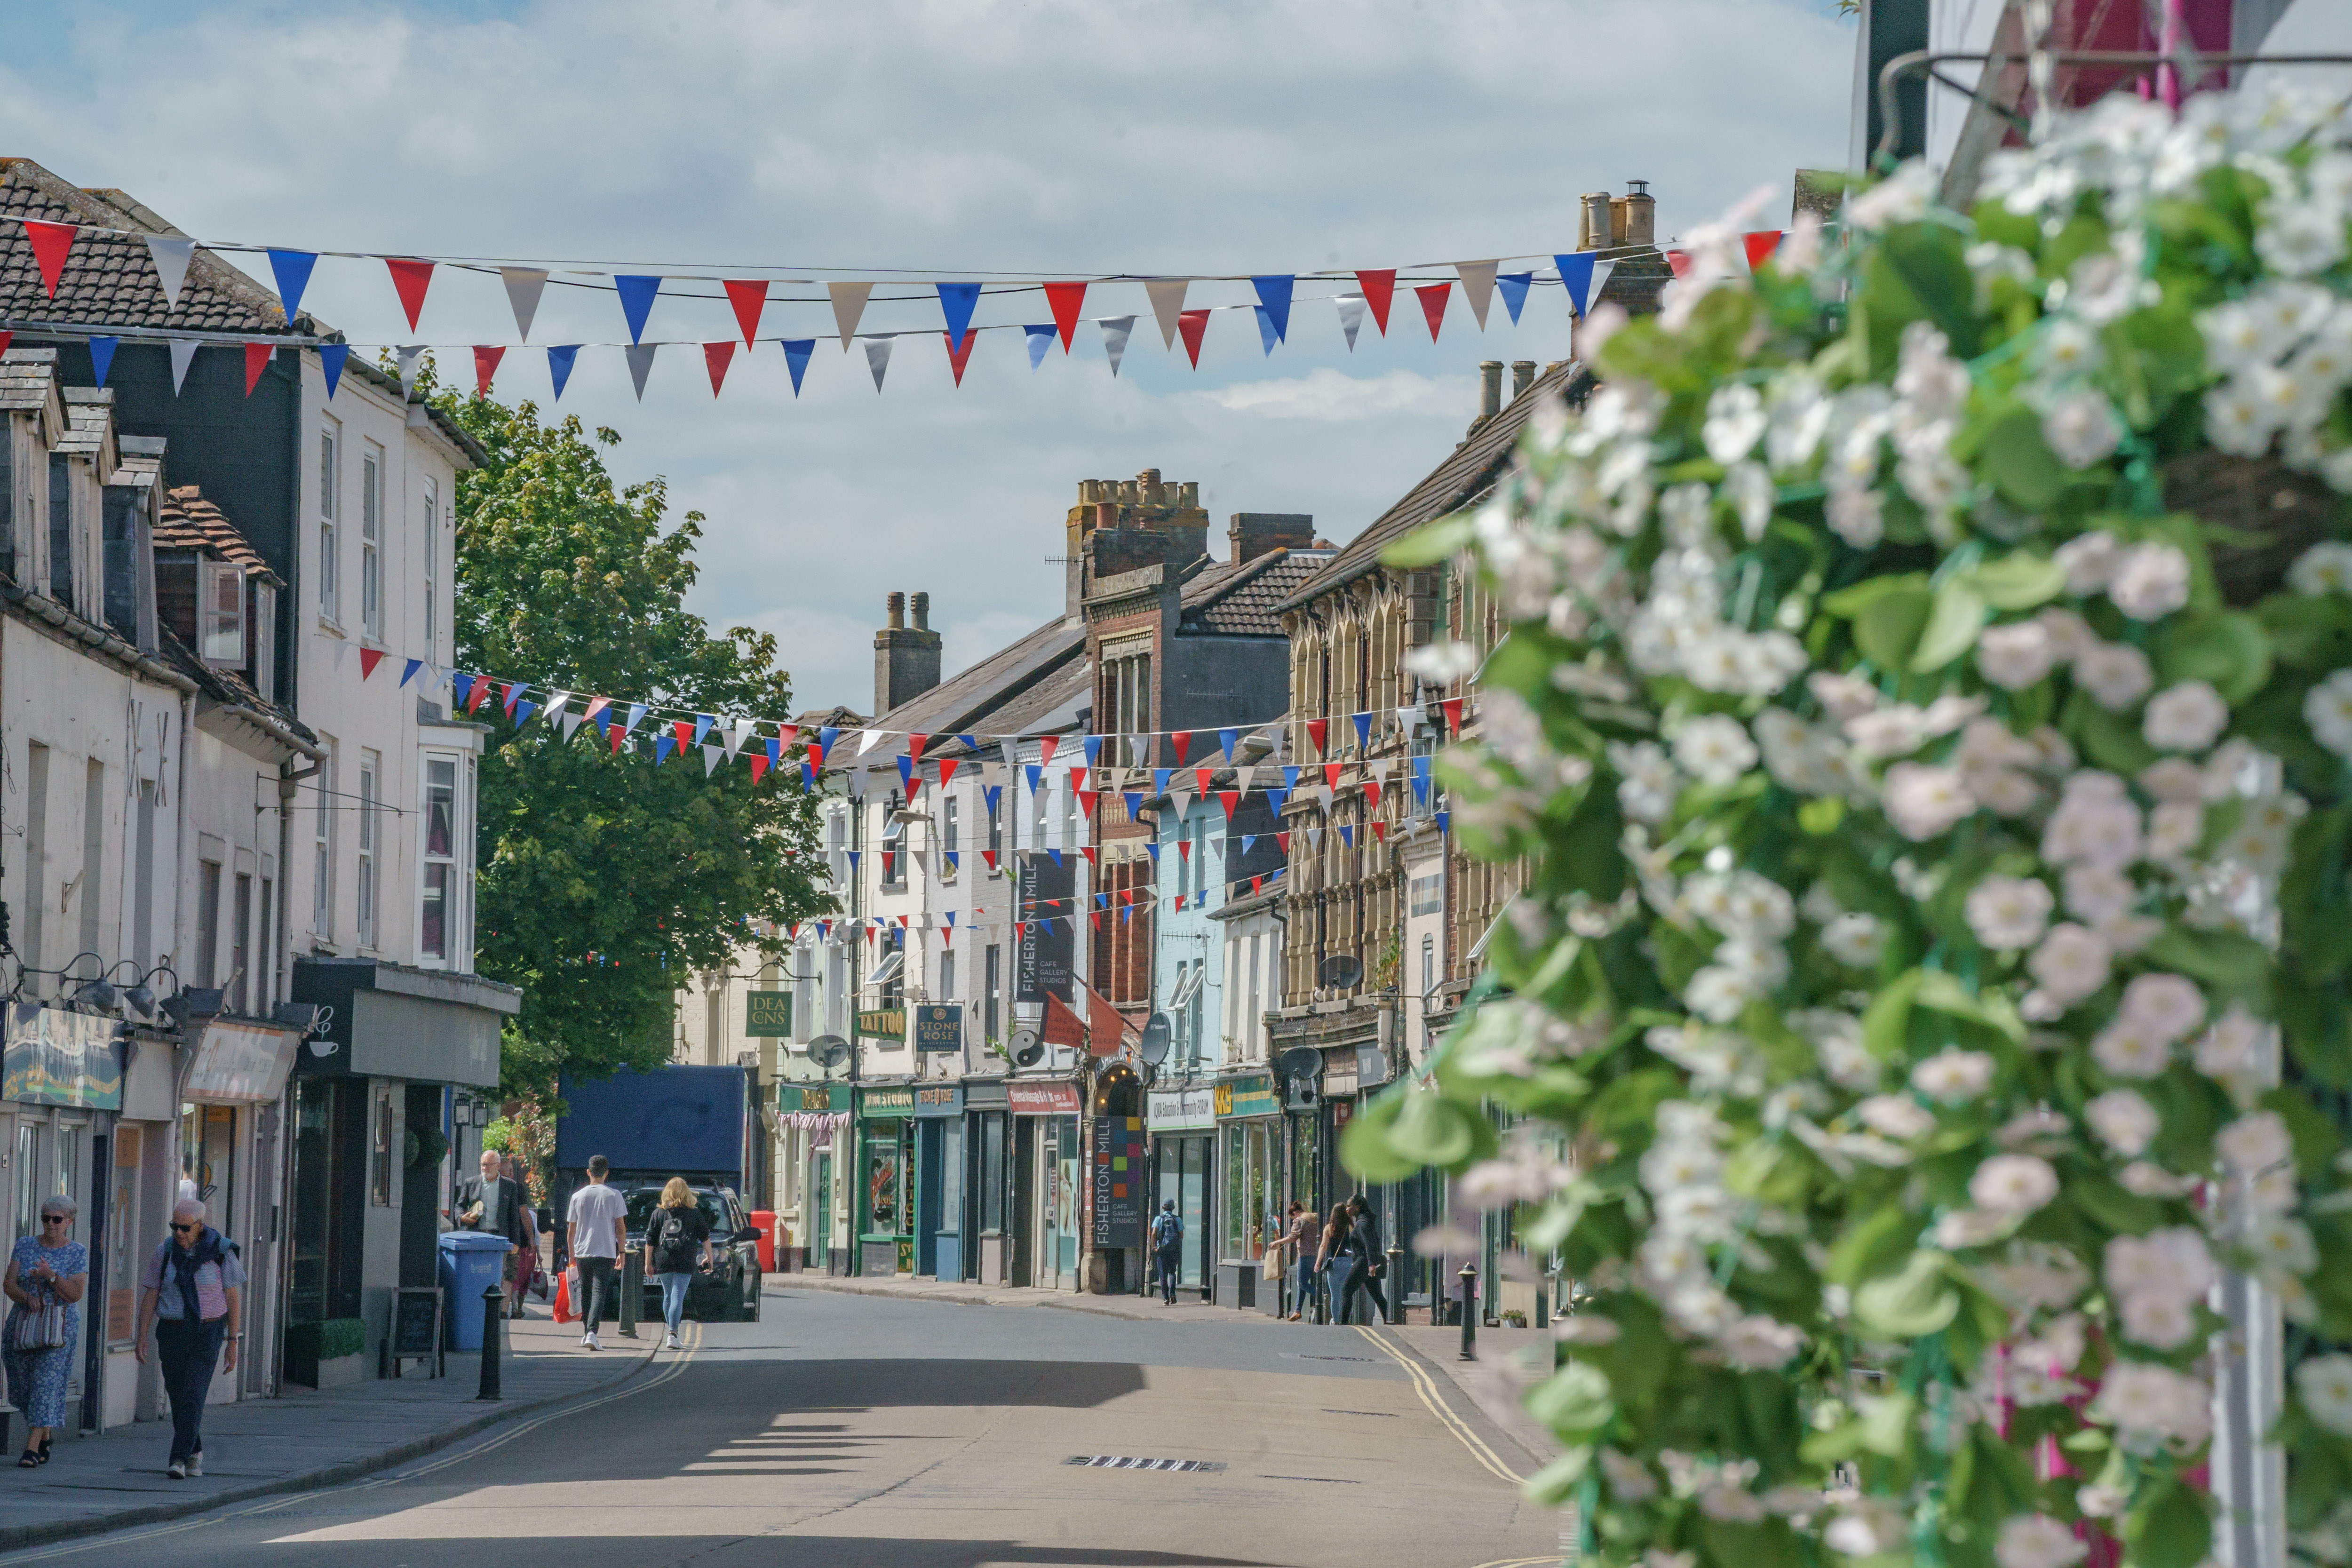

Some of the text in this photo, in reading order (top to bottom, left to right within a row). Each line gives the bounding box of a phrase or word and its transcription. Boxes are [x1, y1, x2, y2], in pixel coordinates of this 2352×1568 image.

[1023, 864, 1037, 992] FISHERTON MILL
[753, 997, 786, 1011] DEA
[858, 1011, 904, 1034] TATTOO
[920, 1022, 959, 1030] STONE
[924, 1032, 954, 1040] ROSE
[882, 1091, 912, 1107] STUDIO
[1010, 1090, 1026, 1102] Oriental
[1197, 1098, 1209, 1115] FORUM
[1097, 1121, 1110, 1243] FISHERTON MILL
